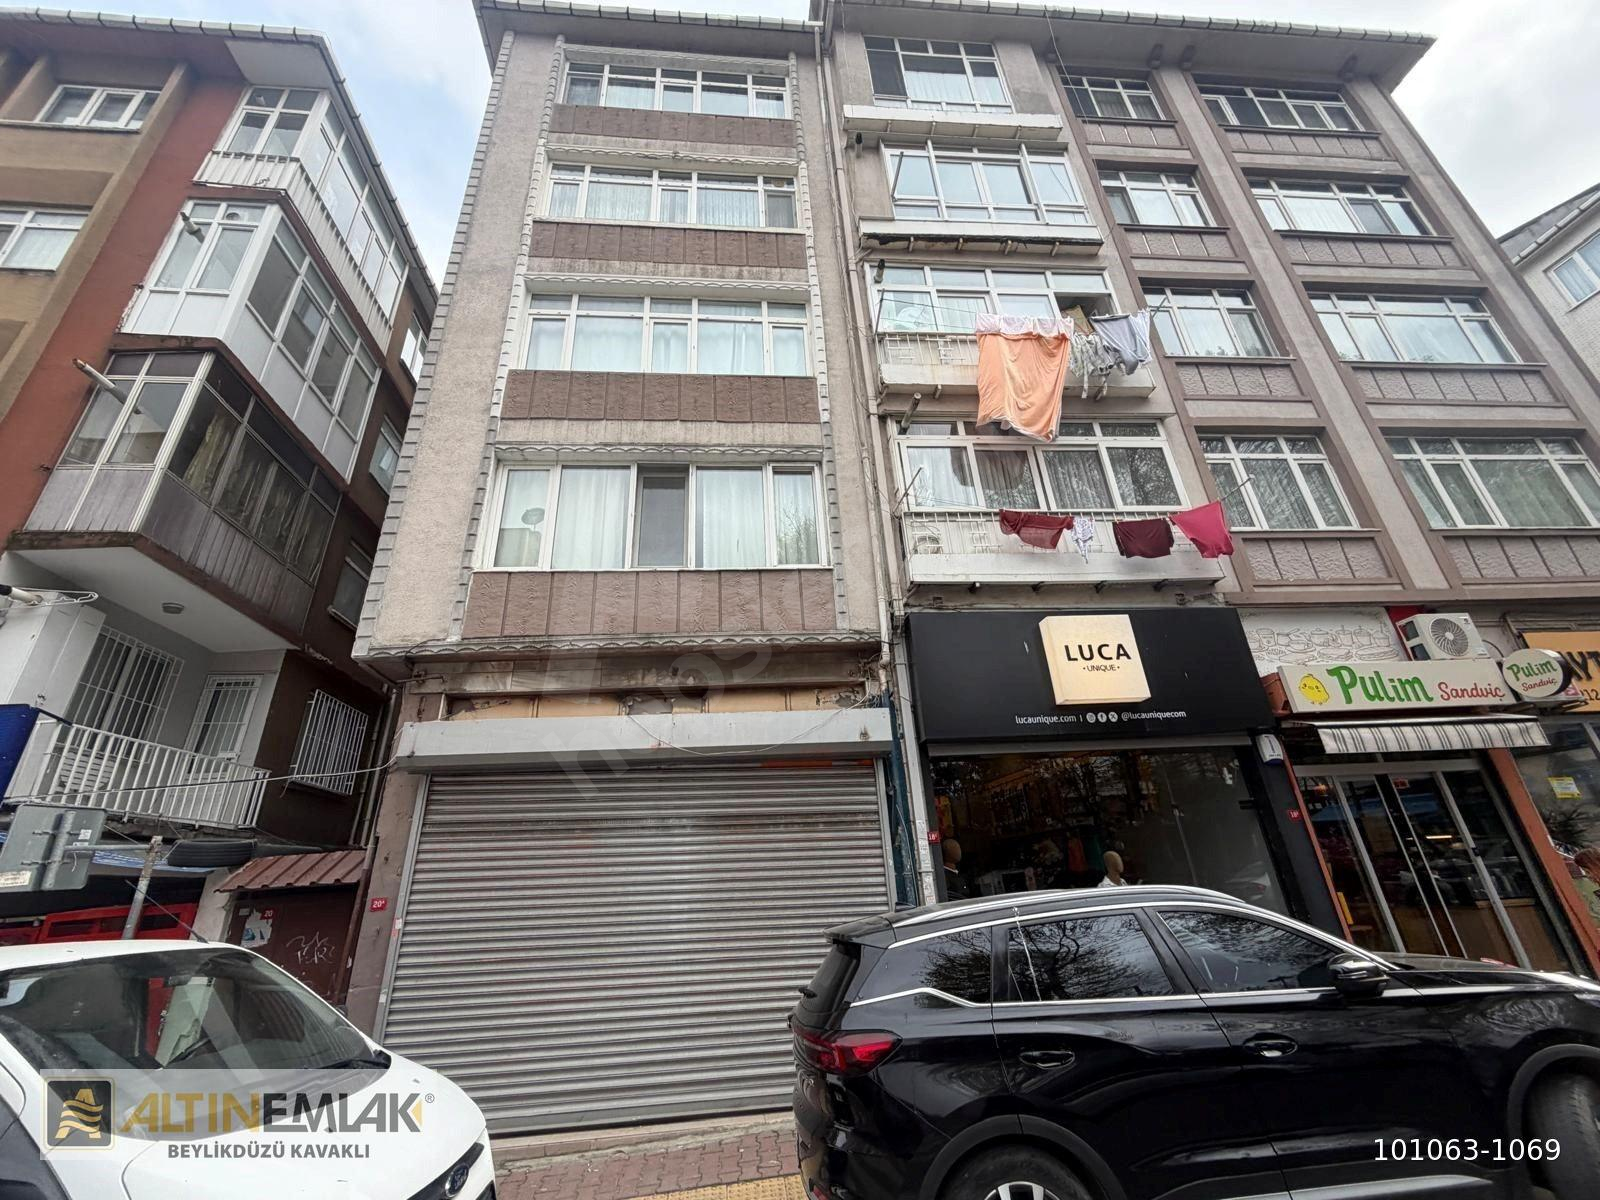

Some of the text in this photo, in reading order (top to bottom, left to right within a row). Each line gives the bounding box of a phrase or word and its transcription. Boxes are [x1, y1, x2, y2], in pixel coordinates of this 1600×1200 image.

[1064, 643, 1132, 662] LUCA
[1506, 660, 1557, 682] Pulim
[1326, 665, 1505, 705] Pulim Sandviç
[1015, 710, 1187, 725] lucaunique.com @lucauniquecom
[264, 909, 274, 918] 20
